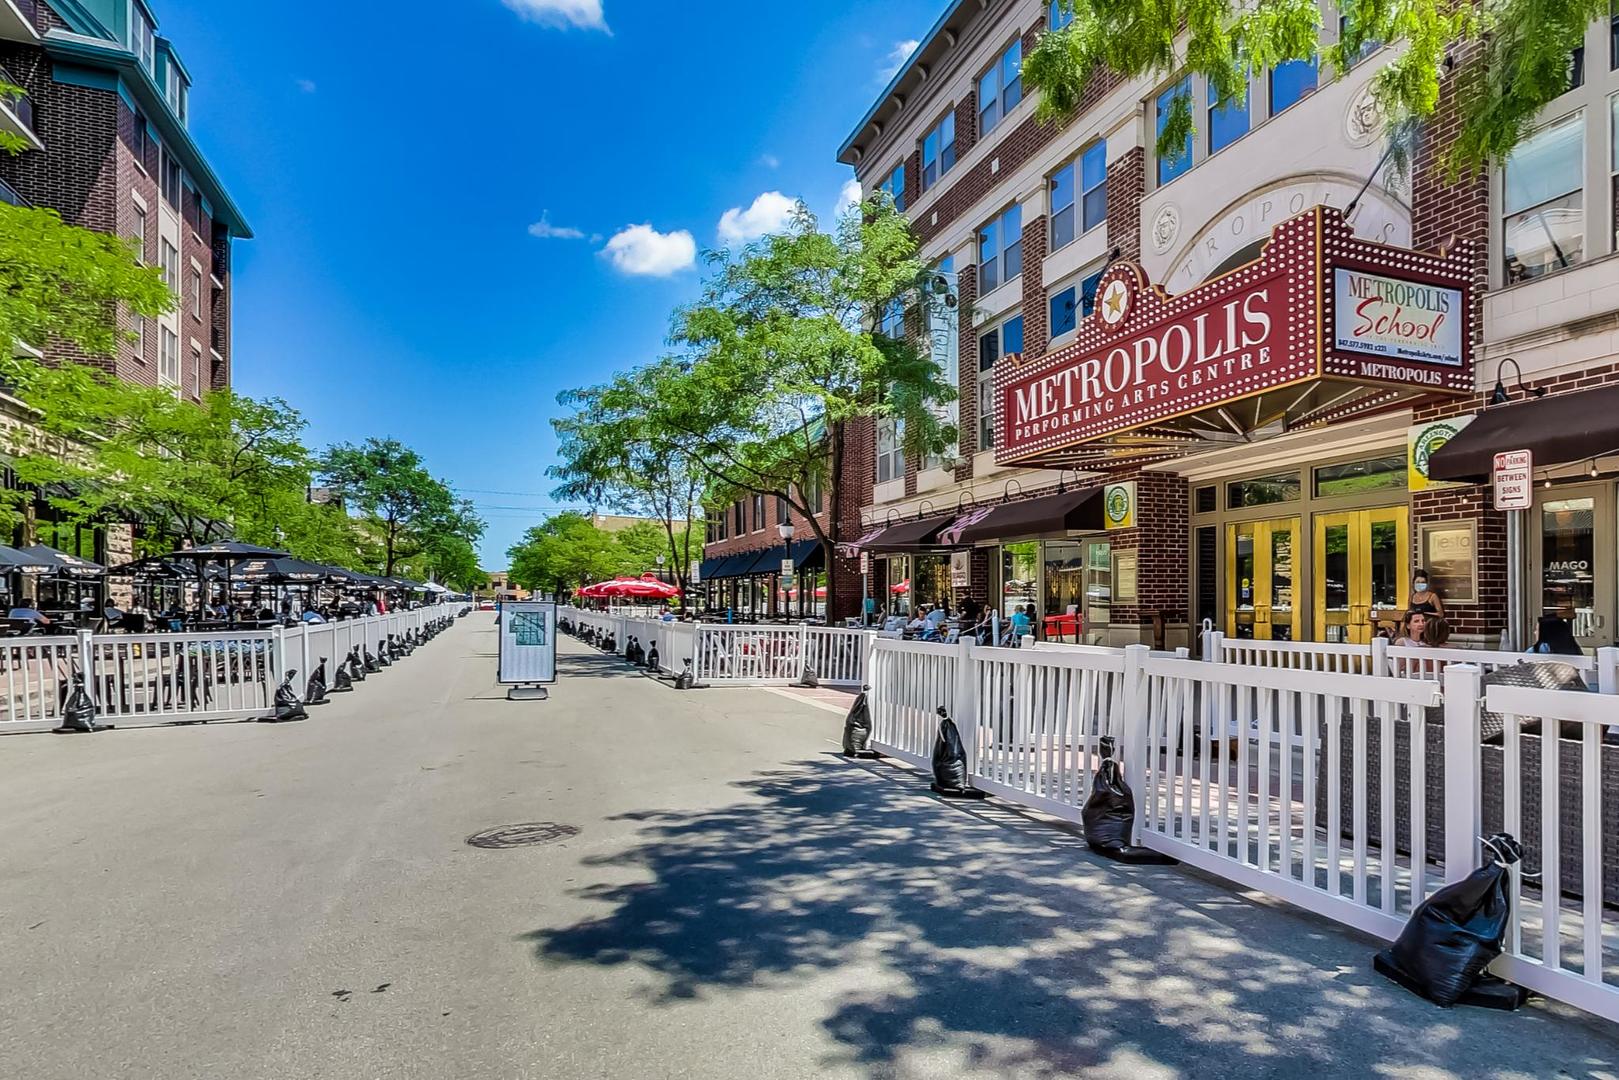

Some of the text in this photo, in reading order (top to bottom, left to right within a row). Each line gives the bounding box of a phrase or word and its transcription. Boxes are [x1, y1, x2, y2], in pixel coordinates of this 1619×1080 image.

[1348, 275, 1449, 313] METROPOLIS
[1353, 296, 1445, 343] School
[1015, 289, 1272, 426] METROPOLIS
[1360, 362, 1442, 384] METROPOLIS
[1015, 346, 1271, 440] PERFORMING ARTS CENTRE
[1496, 456, 1506, 469] NO
[1497, 474, 1527, 483] BETWEEN
[1502, 486, 1521, 494] SIGNS
[1550, 560, 1588, 570] MAGO
